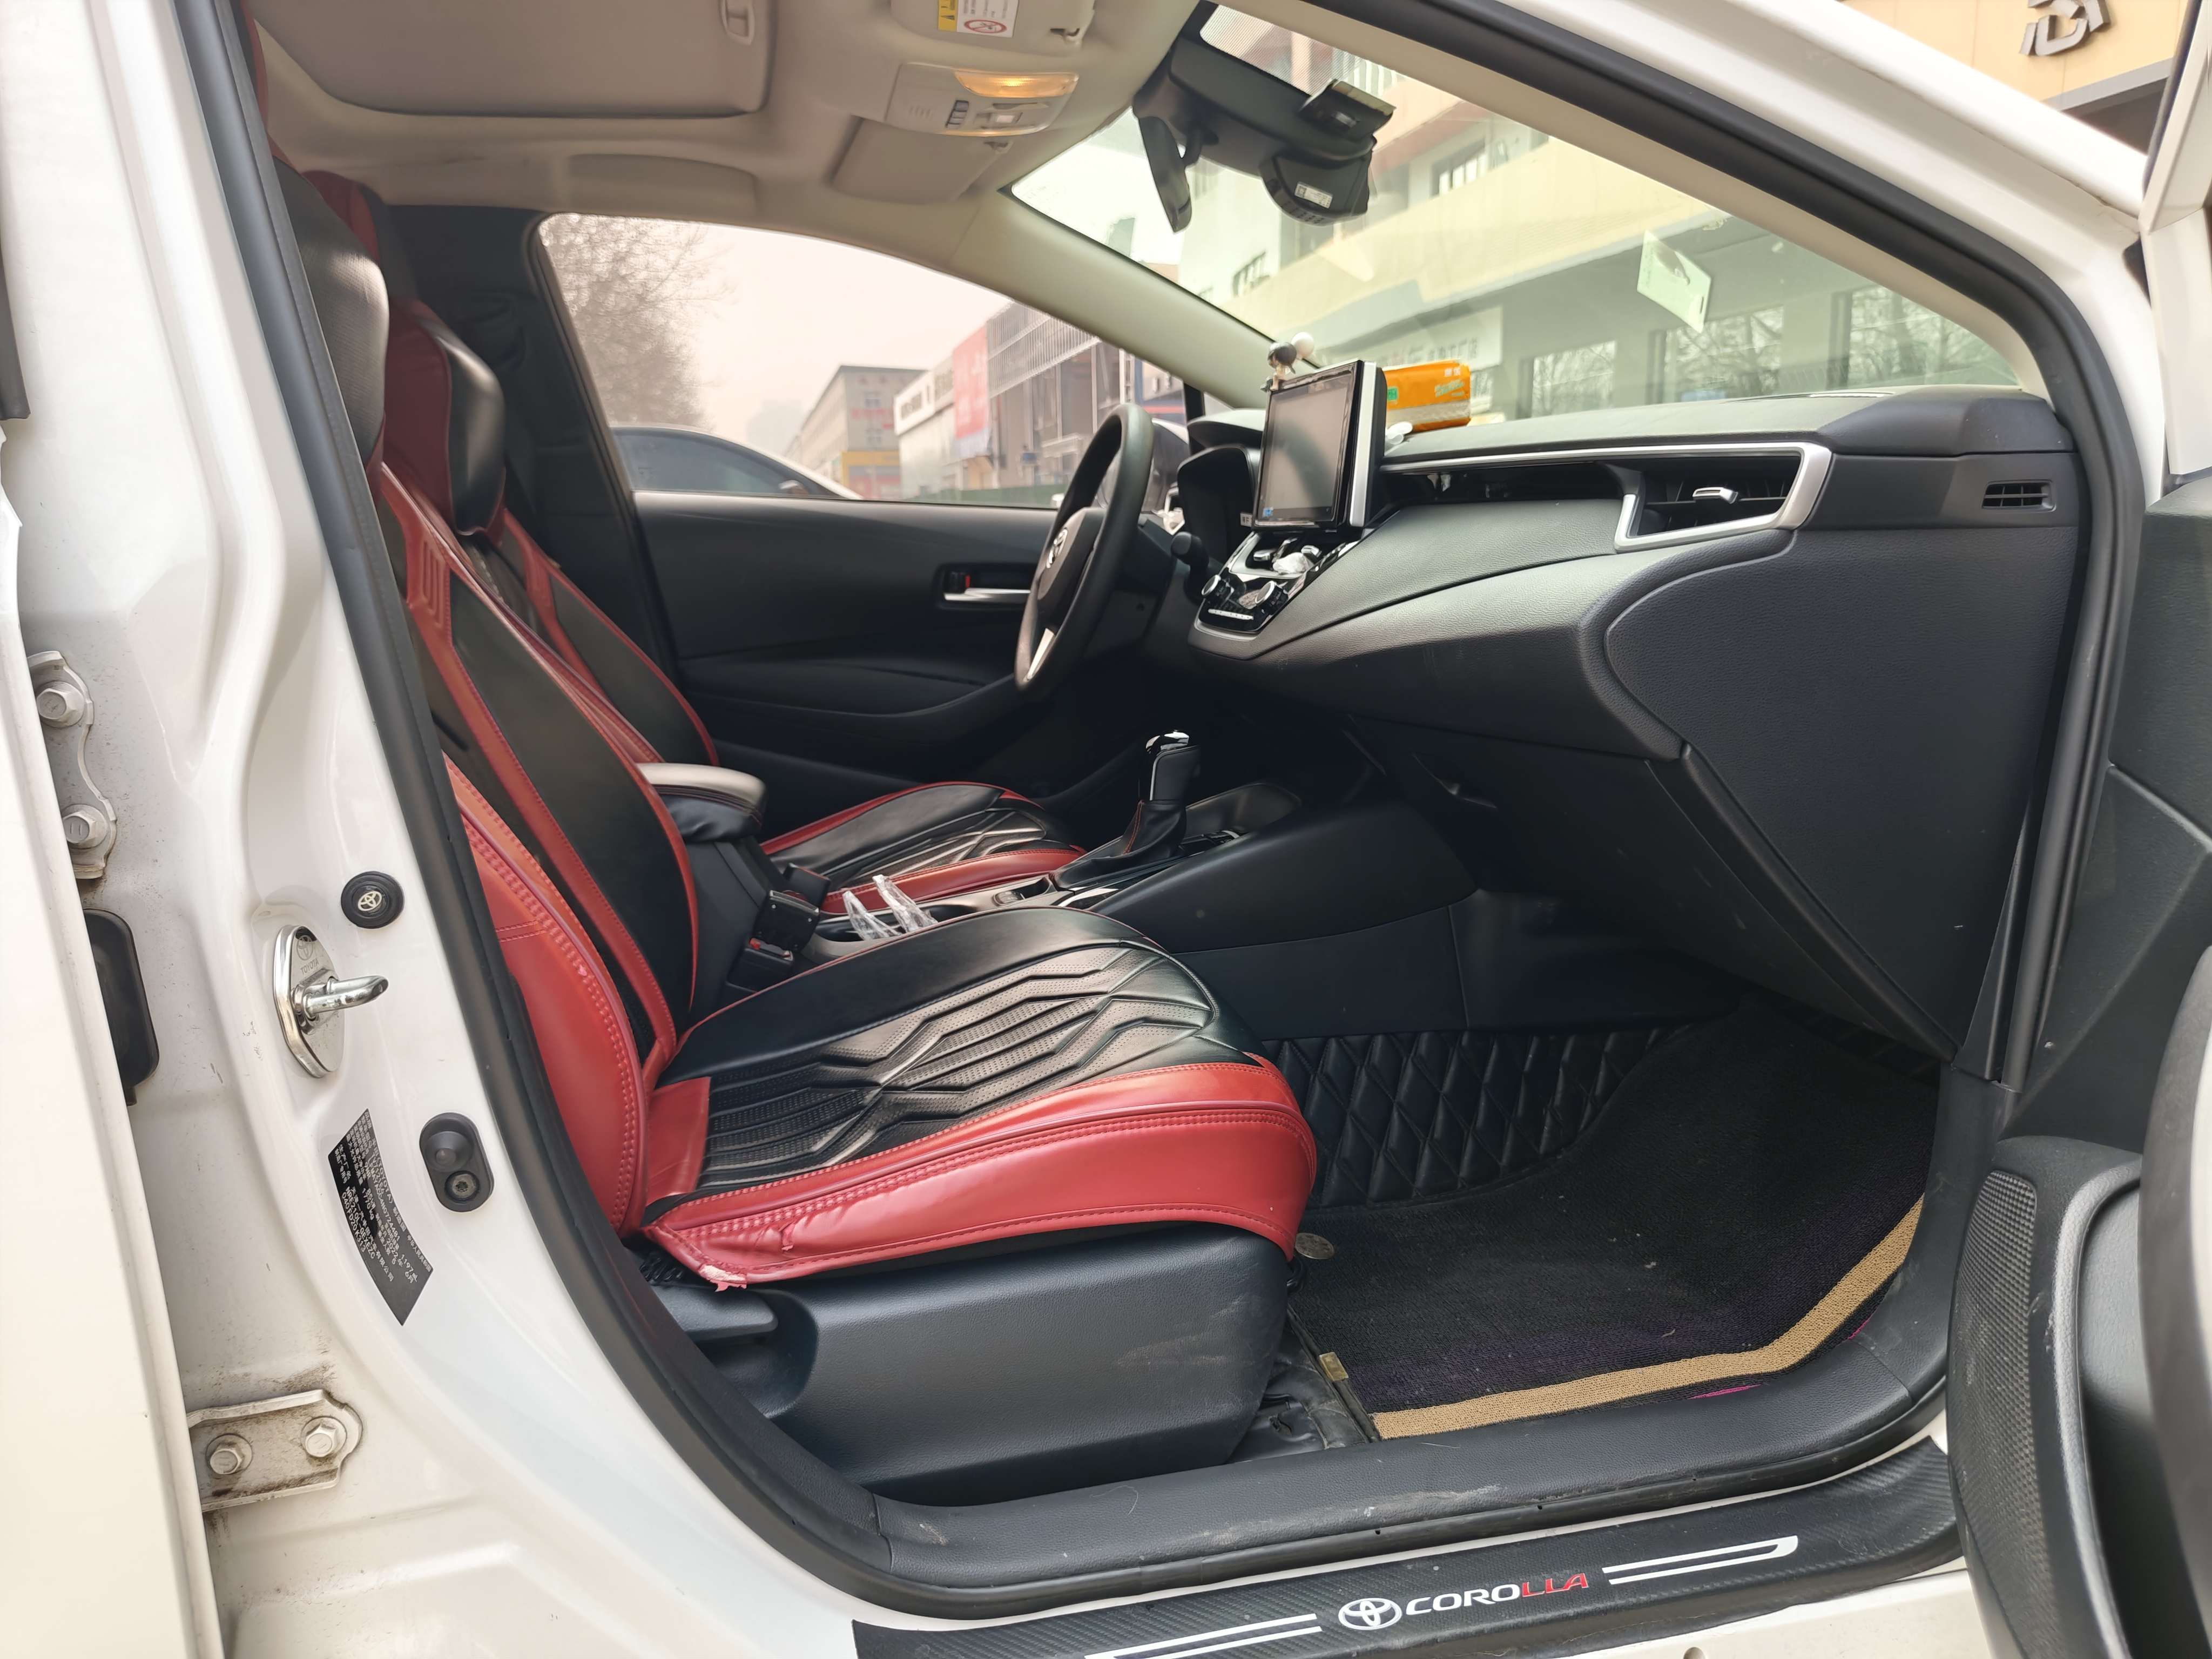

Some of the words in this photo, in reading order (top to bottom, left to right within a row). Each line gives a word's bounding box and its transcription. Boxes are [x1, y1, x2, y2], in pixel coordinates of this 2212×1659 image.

[300, 959, 319, 975] TOYOTA
[339, 1144, 350, 1179] 生产厂名
[407, 1235, 431, 1271] 中华人民共和国
[1406, 1573, 1589, 1615] COROLLA
